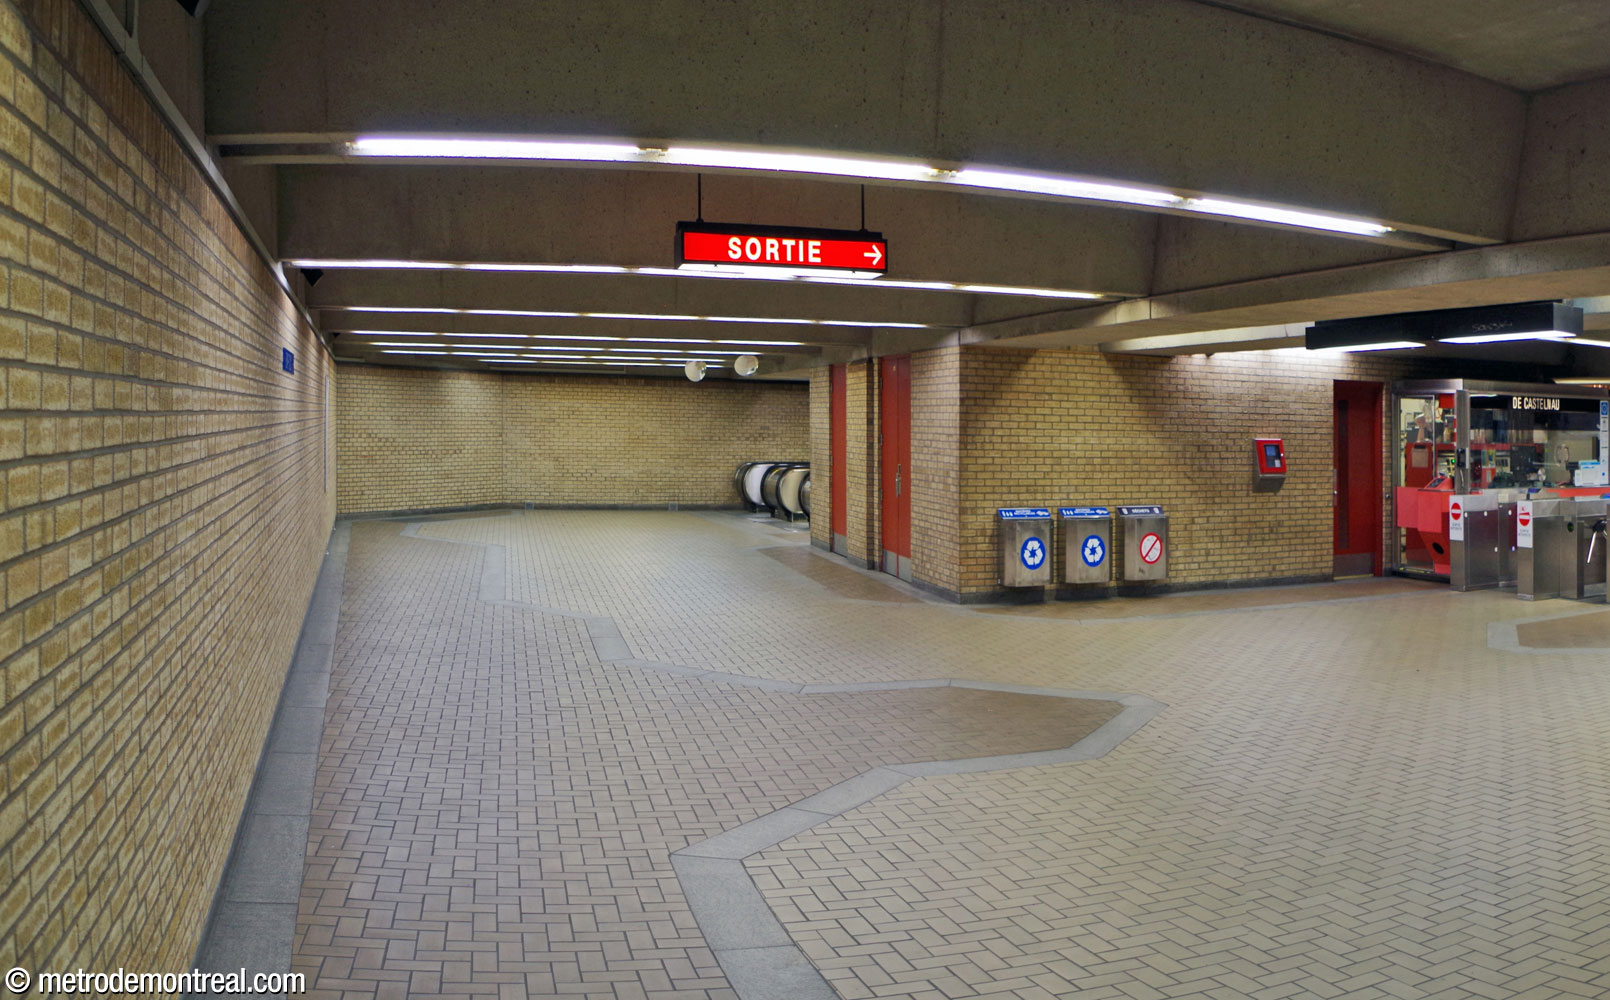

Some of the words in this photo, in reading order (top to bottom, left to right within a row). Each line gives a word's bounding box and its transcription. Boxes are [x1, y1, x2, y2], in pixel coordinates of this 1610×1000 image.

[728, 237, 821, 263] SORTIE
[1512, 396, 1522, 409] DE
[1523, 396, 1560, 410] CASTELNAU
